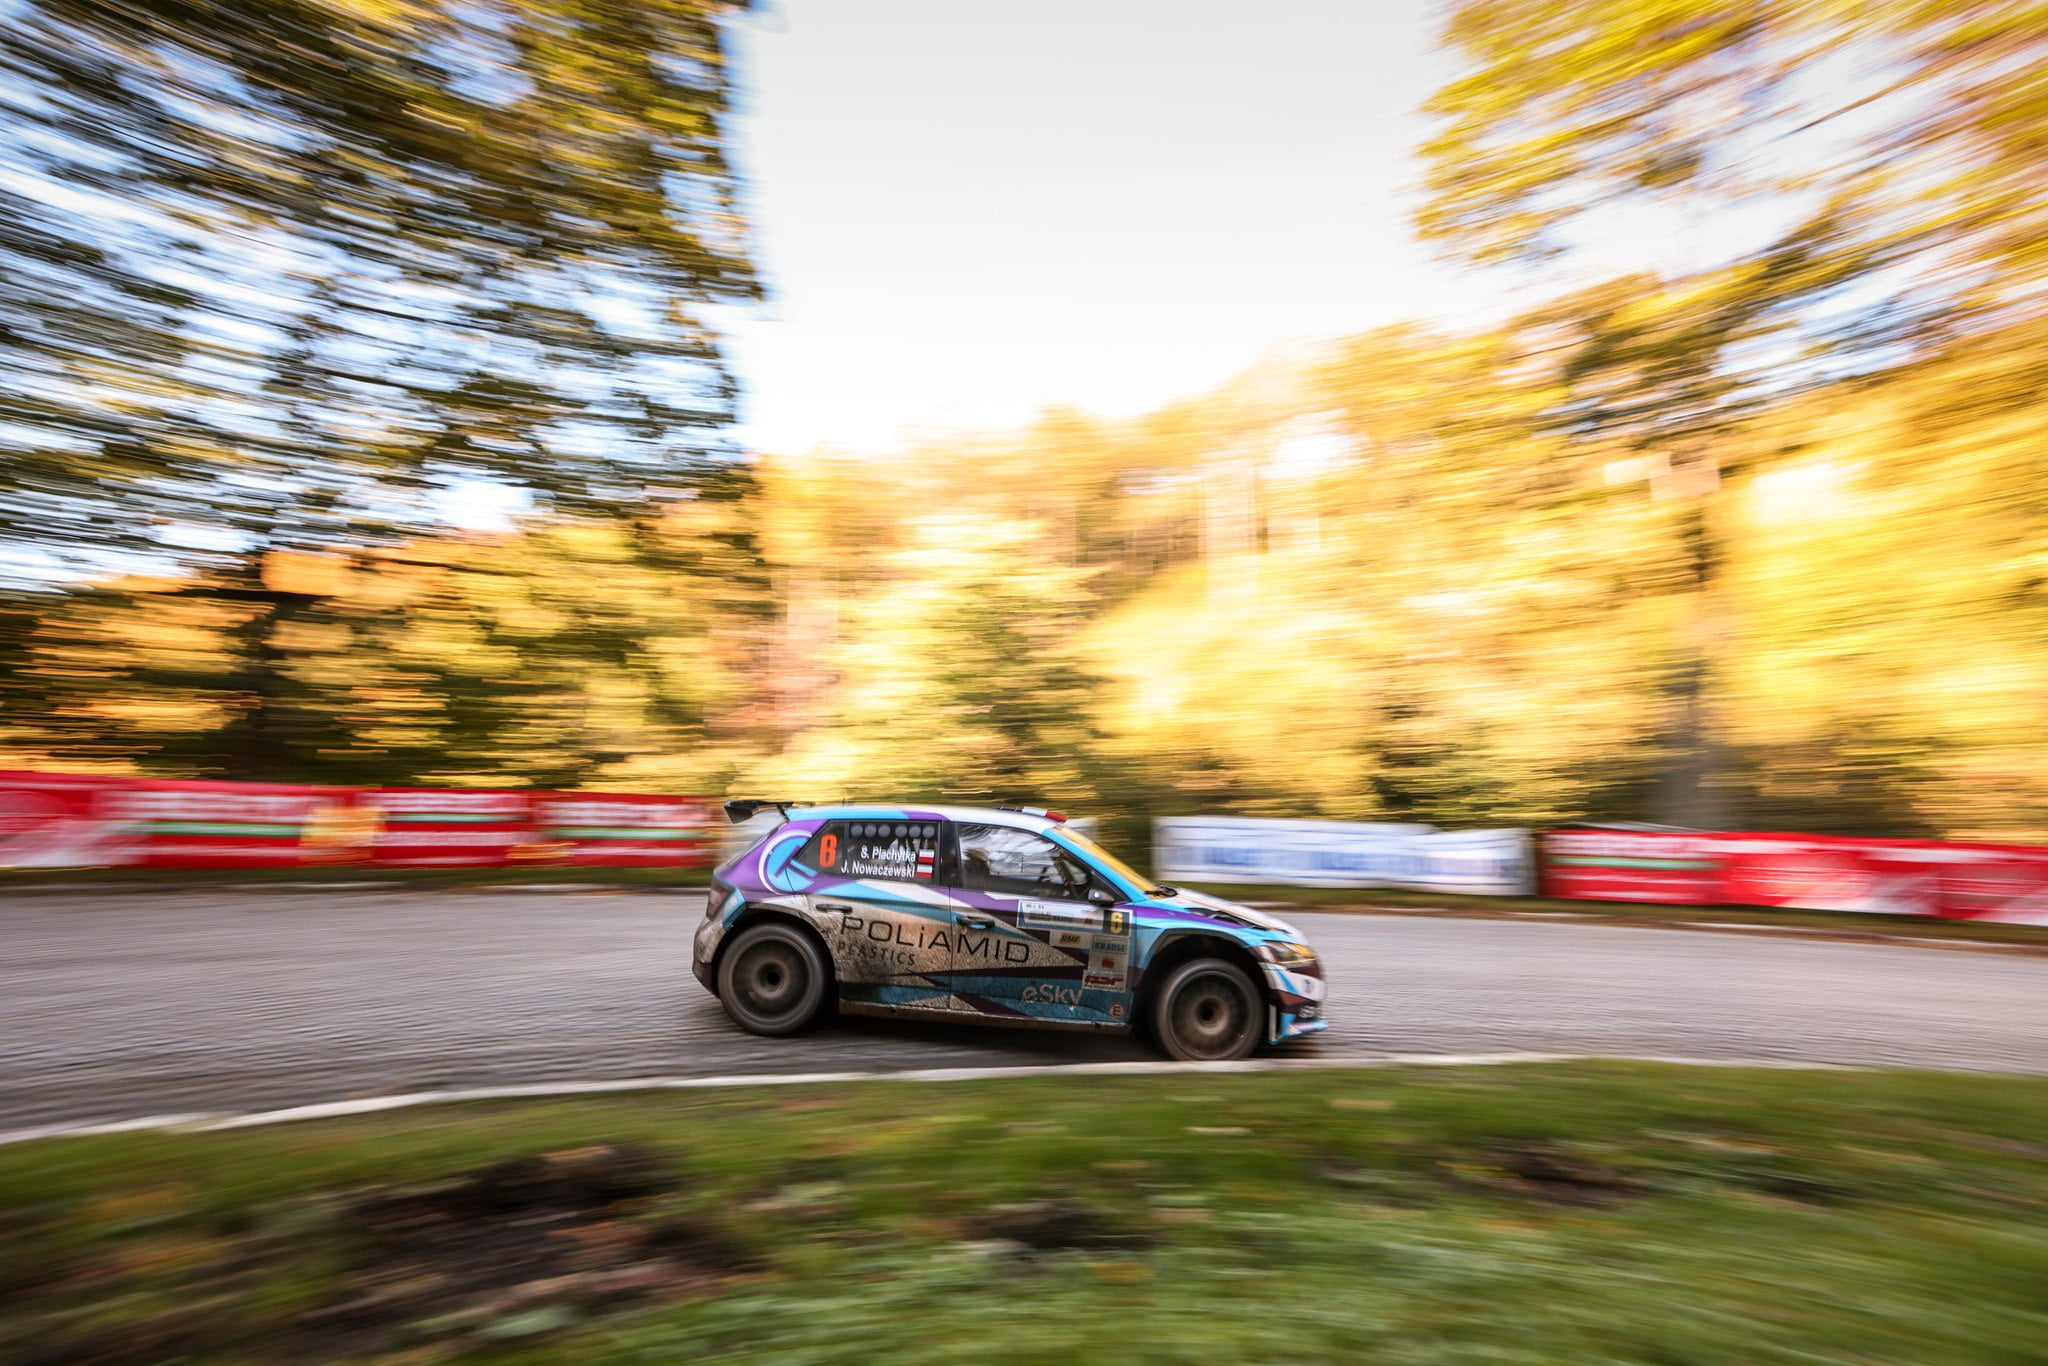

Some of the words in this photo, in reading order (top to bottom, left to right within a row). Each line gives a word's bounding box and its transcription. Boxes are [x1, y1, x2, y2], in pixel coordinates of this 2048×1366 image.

[820, 833, 837, 868] 6
[860, 845, 869, 859] S.
[841, 860, 849, 874] J.
[852, 860, 916, 877] Nowaczewski
[1110, 911, 1124, 934] 6
[837, 942, 916, 964] PLASTICS
[1094, 941, 1126, 953] KRAUSE
[1021, 984, 1083, 1011] eSky
[1112, 1006, 1121, 1017] E
